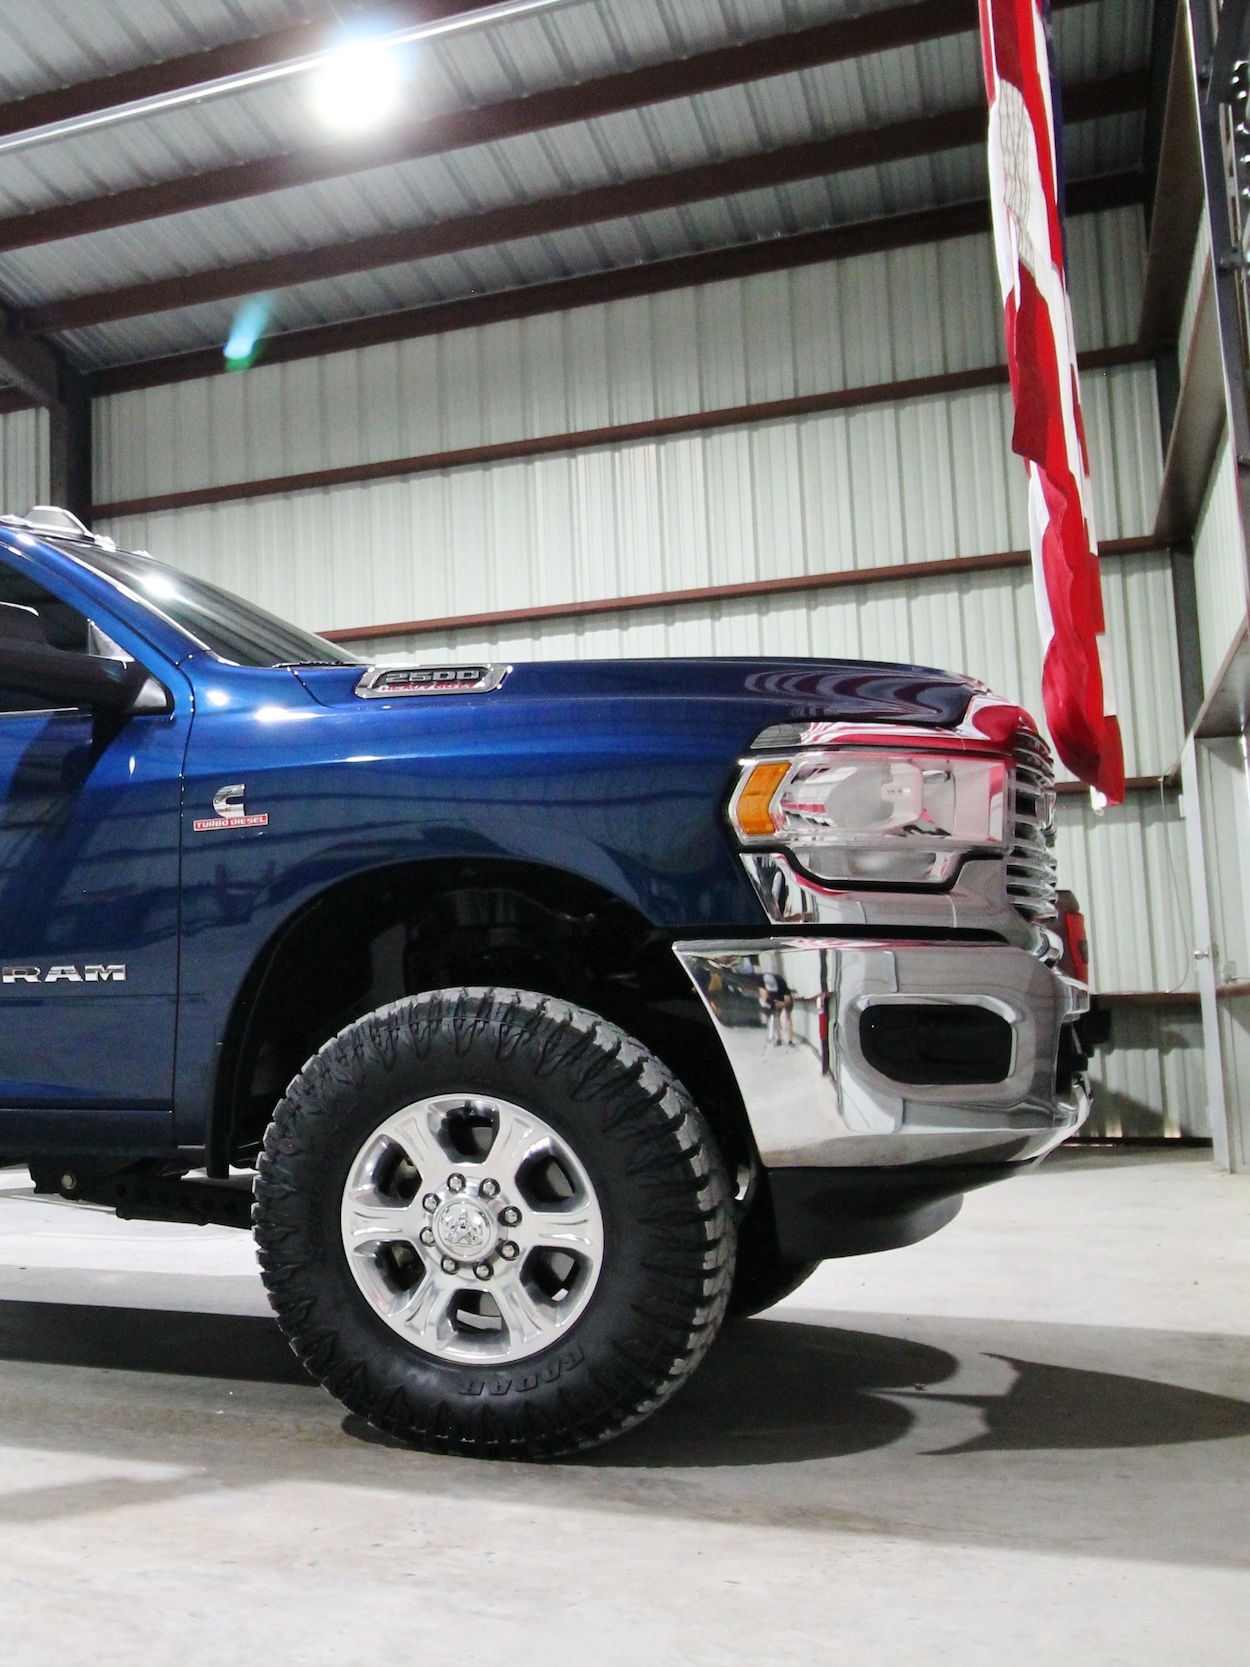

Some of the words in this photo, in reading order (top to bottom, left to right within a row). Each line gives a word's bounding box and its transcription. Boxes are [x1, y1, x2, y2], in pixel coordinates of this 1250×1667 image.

[385, 670, 479, 682] 2500
[196, 819, 229, 829] TURBO
[230, 816, 266, 826] DIESEL
[1, 963, 127, 984] RAM
